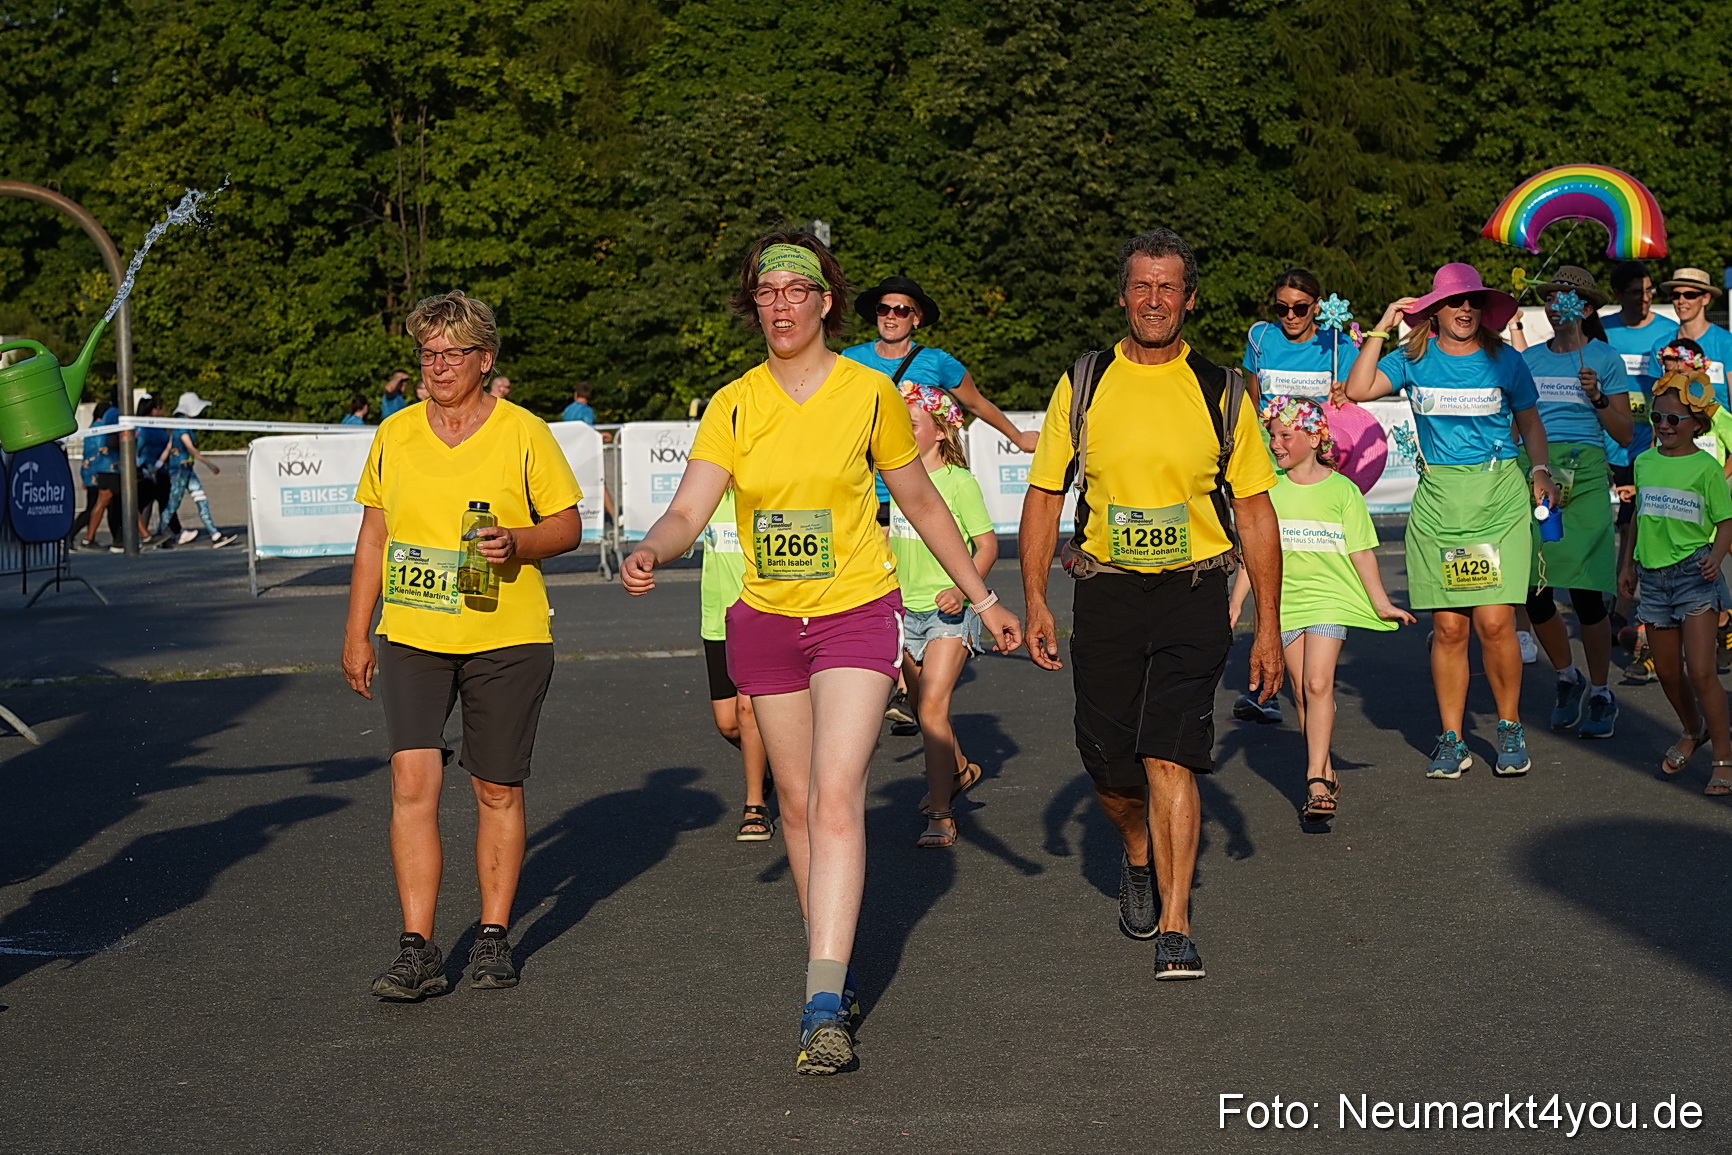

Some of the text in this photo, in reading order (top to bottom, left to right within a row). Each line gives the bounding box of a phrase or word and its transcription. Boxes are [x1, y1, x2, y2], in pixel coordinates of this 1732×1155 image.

[1556, 383, 1582, 391] Grundsc
[1631, 402, 1645, 413] 33
[998, 440, 1021, 455] NO
[651, 448, 692, 463] NOW
[278, 460, 322, 477] NOW
[22, 480, 65, 503] Fischer
[283, 487, 348, 503] E-BIKES
[1645, 493, 1661, 502] Freie
[1672, 505, 1693, 514] Marien
[1122, 527, 1177, 547] 1288
[1283, 528, 1301, 536] Freie
[763, 534, 818, 556] 1266
[821, 537, 829, 568] 2022
[1121, 547, 1179, 555] Schlierf Johann
[1452, 560, 1489, 576] 1429
[389, 566, 397, 595] WALK
[399, 565, 448, 591] 1281
[394, 586, 421, 597] Kienlein
[423, 591, 450, 601] Martina
